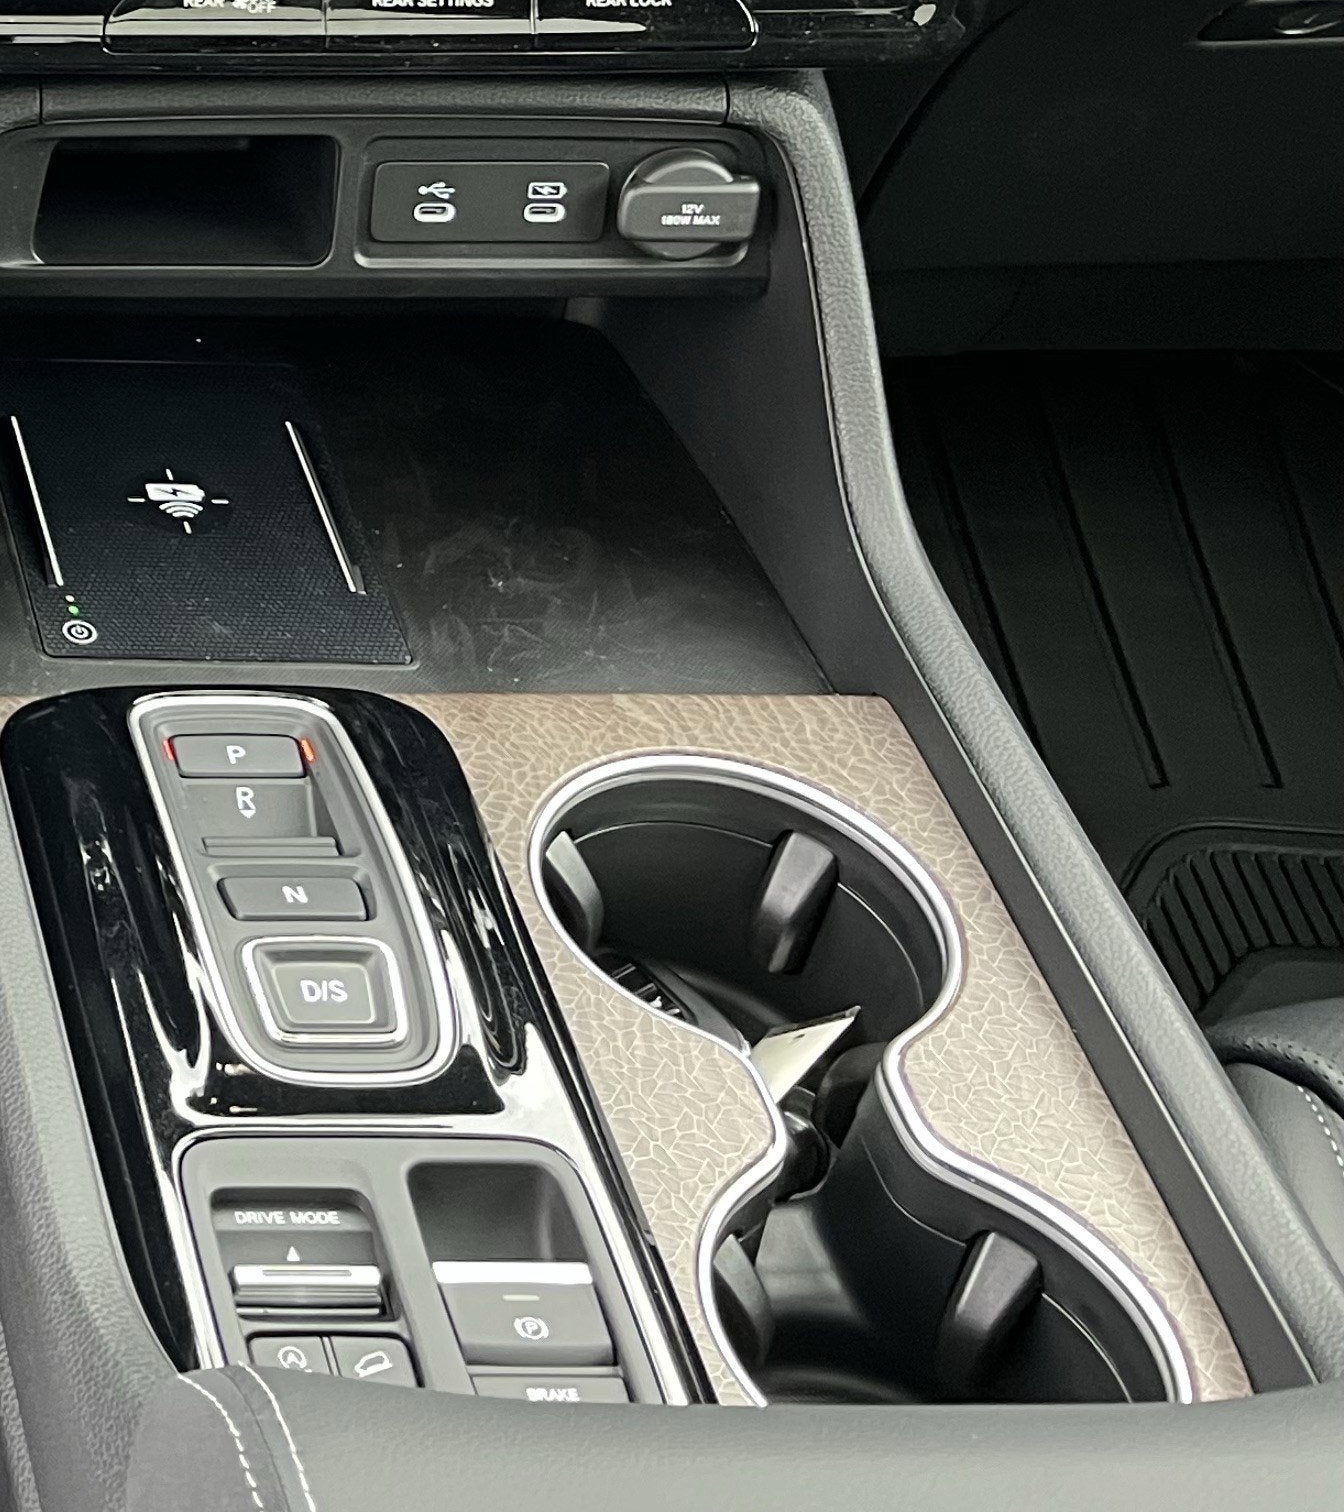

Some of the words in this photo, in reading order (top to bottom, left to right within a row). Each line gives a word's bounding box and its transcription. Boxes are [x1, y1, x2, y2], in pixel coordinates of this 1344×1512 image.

[247, 1, 277, 14] OFF
[681, 204, 705, 214] 12V
[692, 215, 721, 225] MAX
[226, 745, 246, 765] P
[236, 787, 254, 809] R
[282, 885, 308, 903] N
[300, 980, 348, 1003] D/S
[234, 1210, 285, 1225] DRIVE
[290, 1210, 341, 1225] MODE
[526, 1388, 580, 1402] BRAKE
